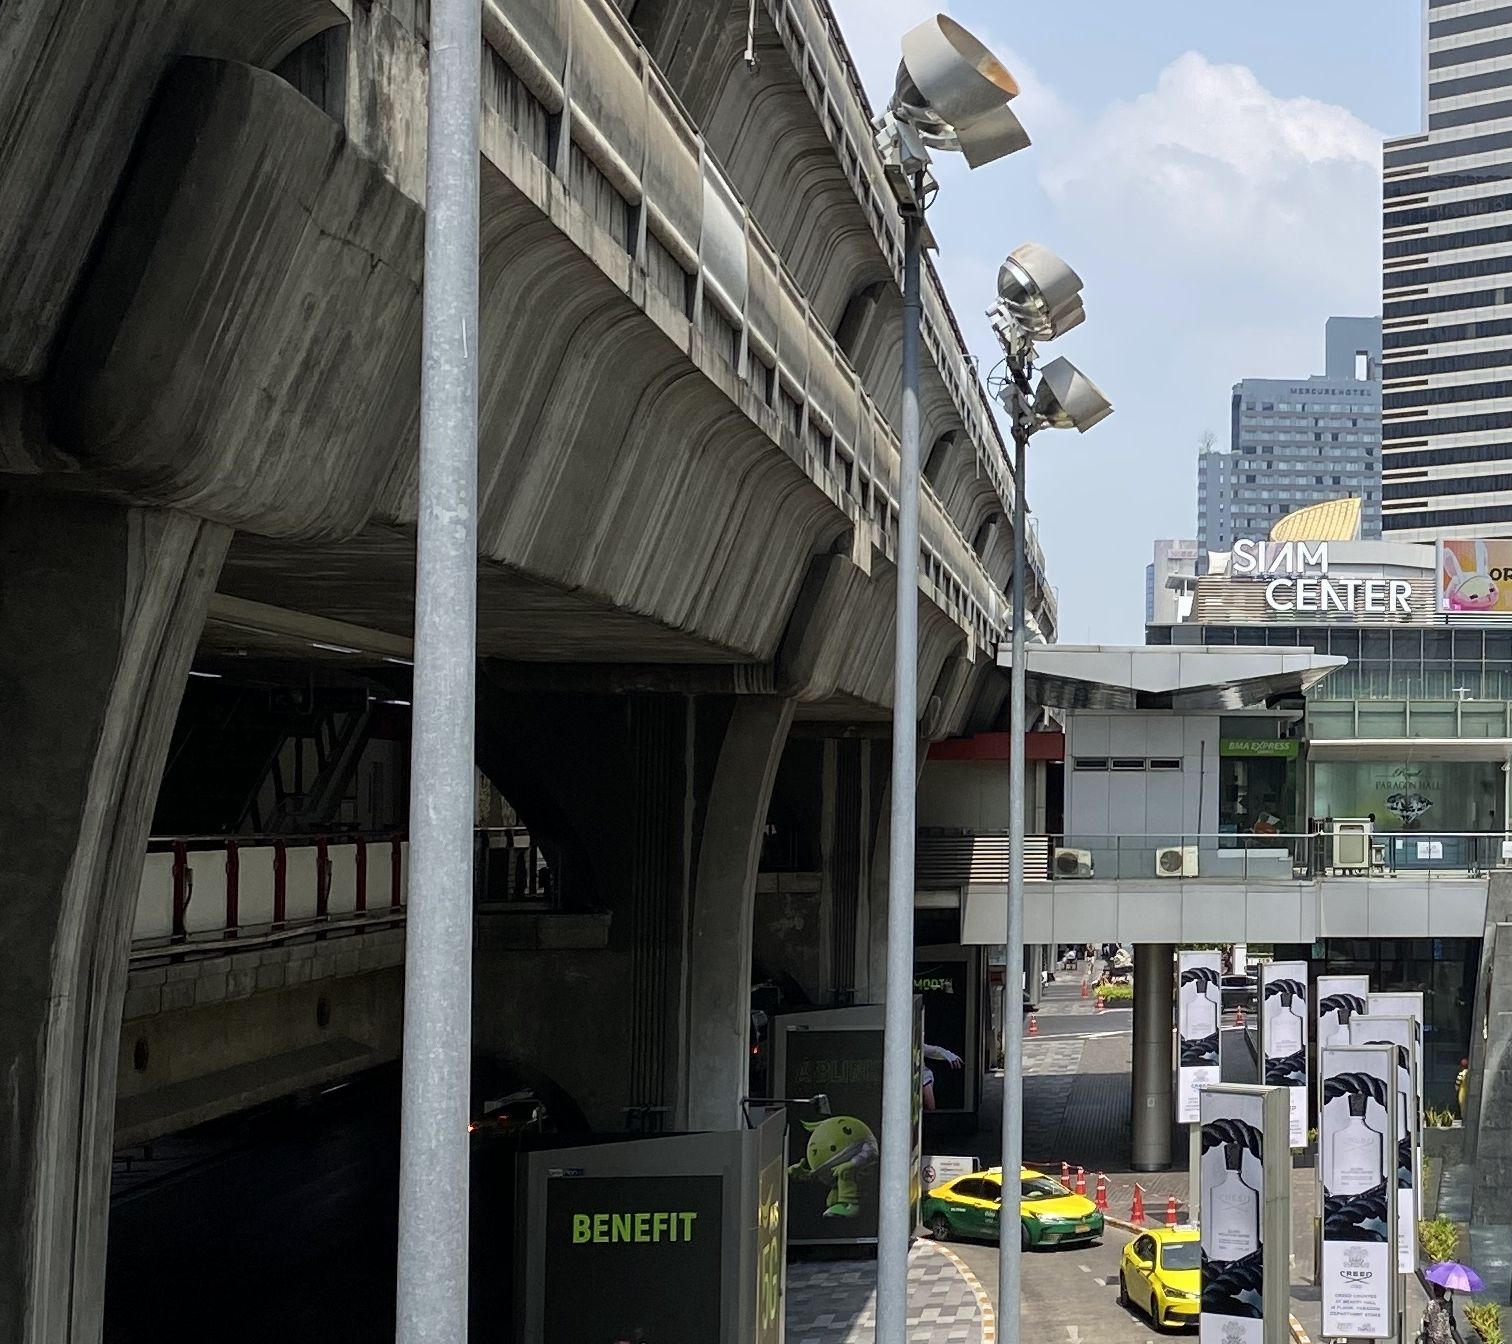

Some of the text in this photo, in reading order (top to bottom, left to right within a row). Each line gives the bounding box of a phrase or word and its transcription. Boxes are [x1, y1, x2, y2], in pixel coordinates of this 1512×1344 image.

[1290, 388, 1337, 396] MERCURE
[1233, 539, 1328, 573] SIAM
[1265, 578, 1412, 612] CENTER
[1229, 741, 1290, 751] BMA EXPRESS
[572, 1212, 697, 1244] BENEFIT
